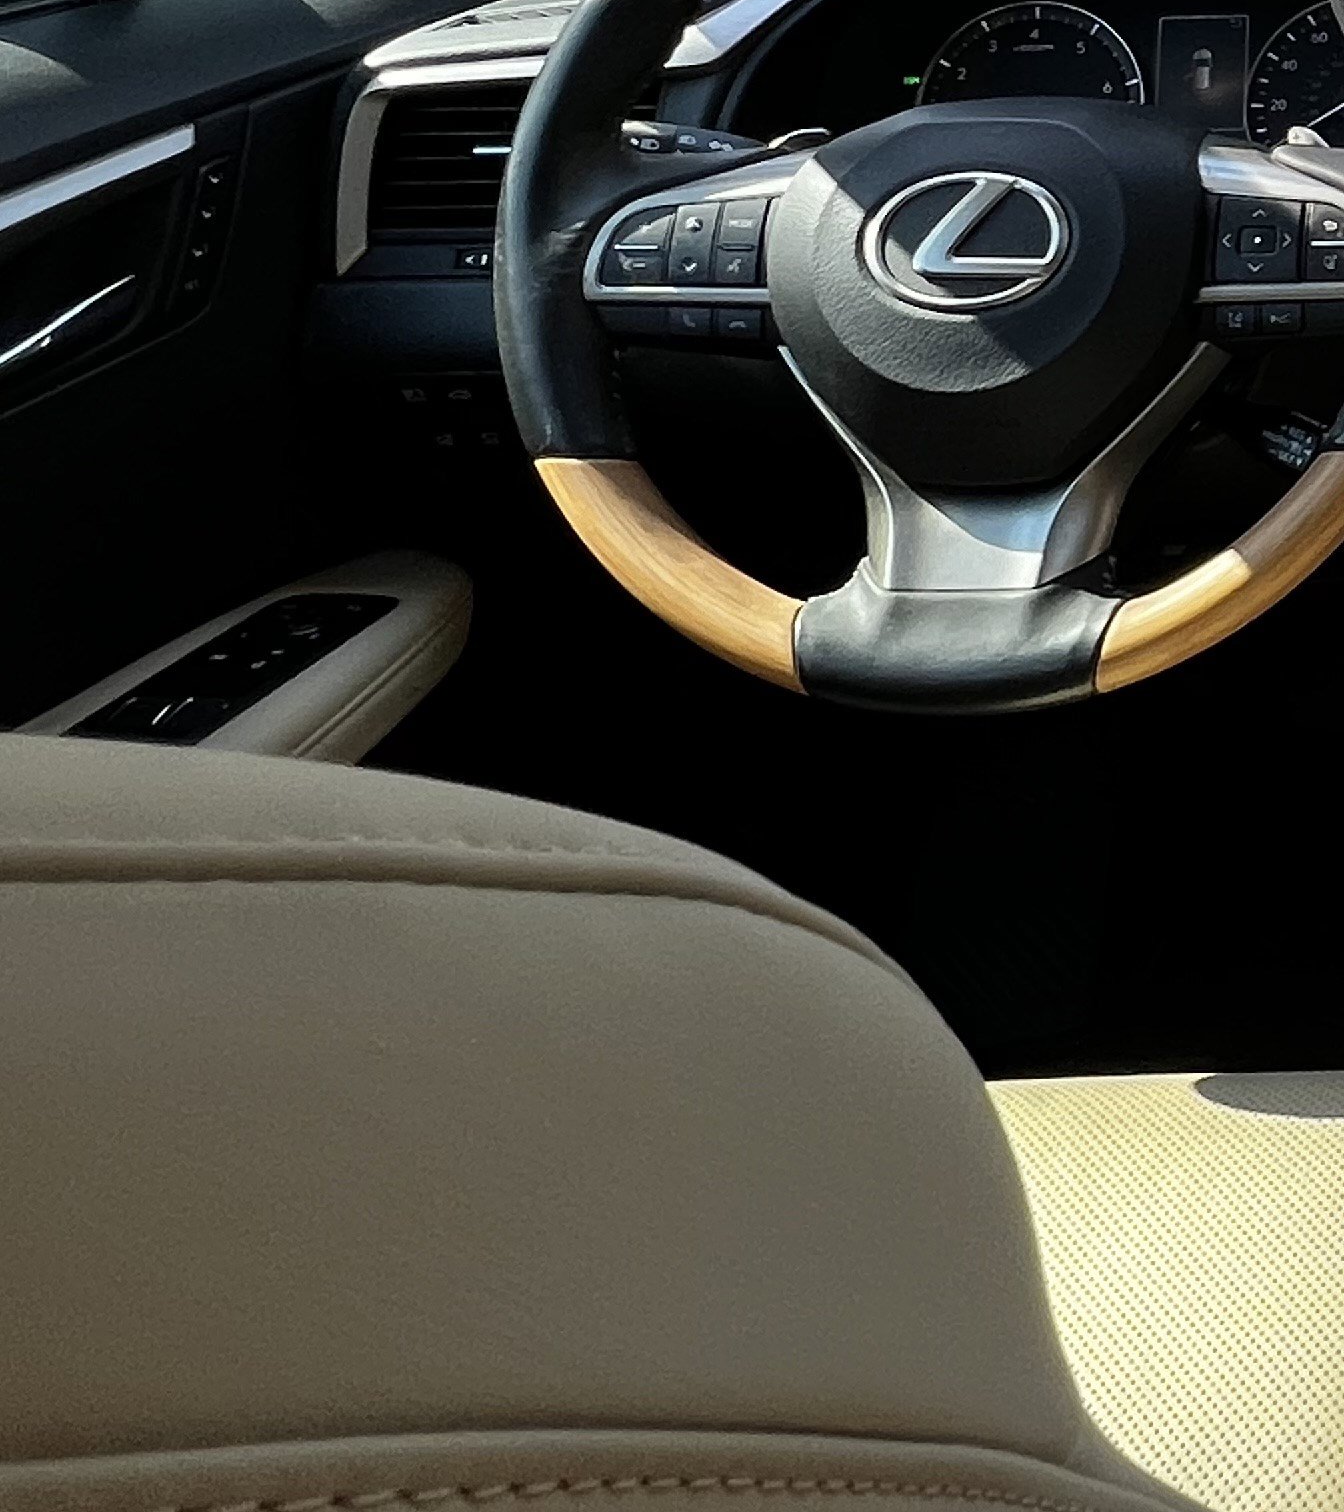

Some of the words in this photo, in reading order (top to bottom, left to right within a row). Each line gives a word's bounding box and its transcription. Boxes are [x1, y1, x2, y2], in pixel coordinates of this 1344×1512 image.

[1028, 27, 1041, 40] 4
[1309, 31, 1329, 44] 60
[987, 39, 998, 53] 3
[1075, 41, 1087, 54] 5
[1280, 59, 1298, 72] 40
[956, 67, 968, 81] 2
[1269, 98, 1288, 112] 20
